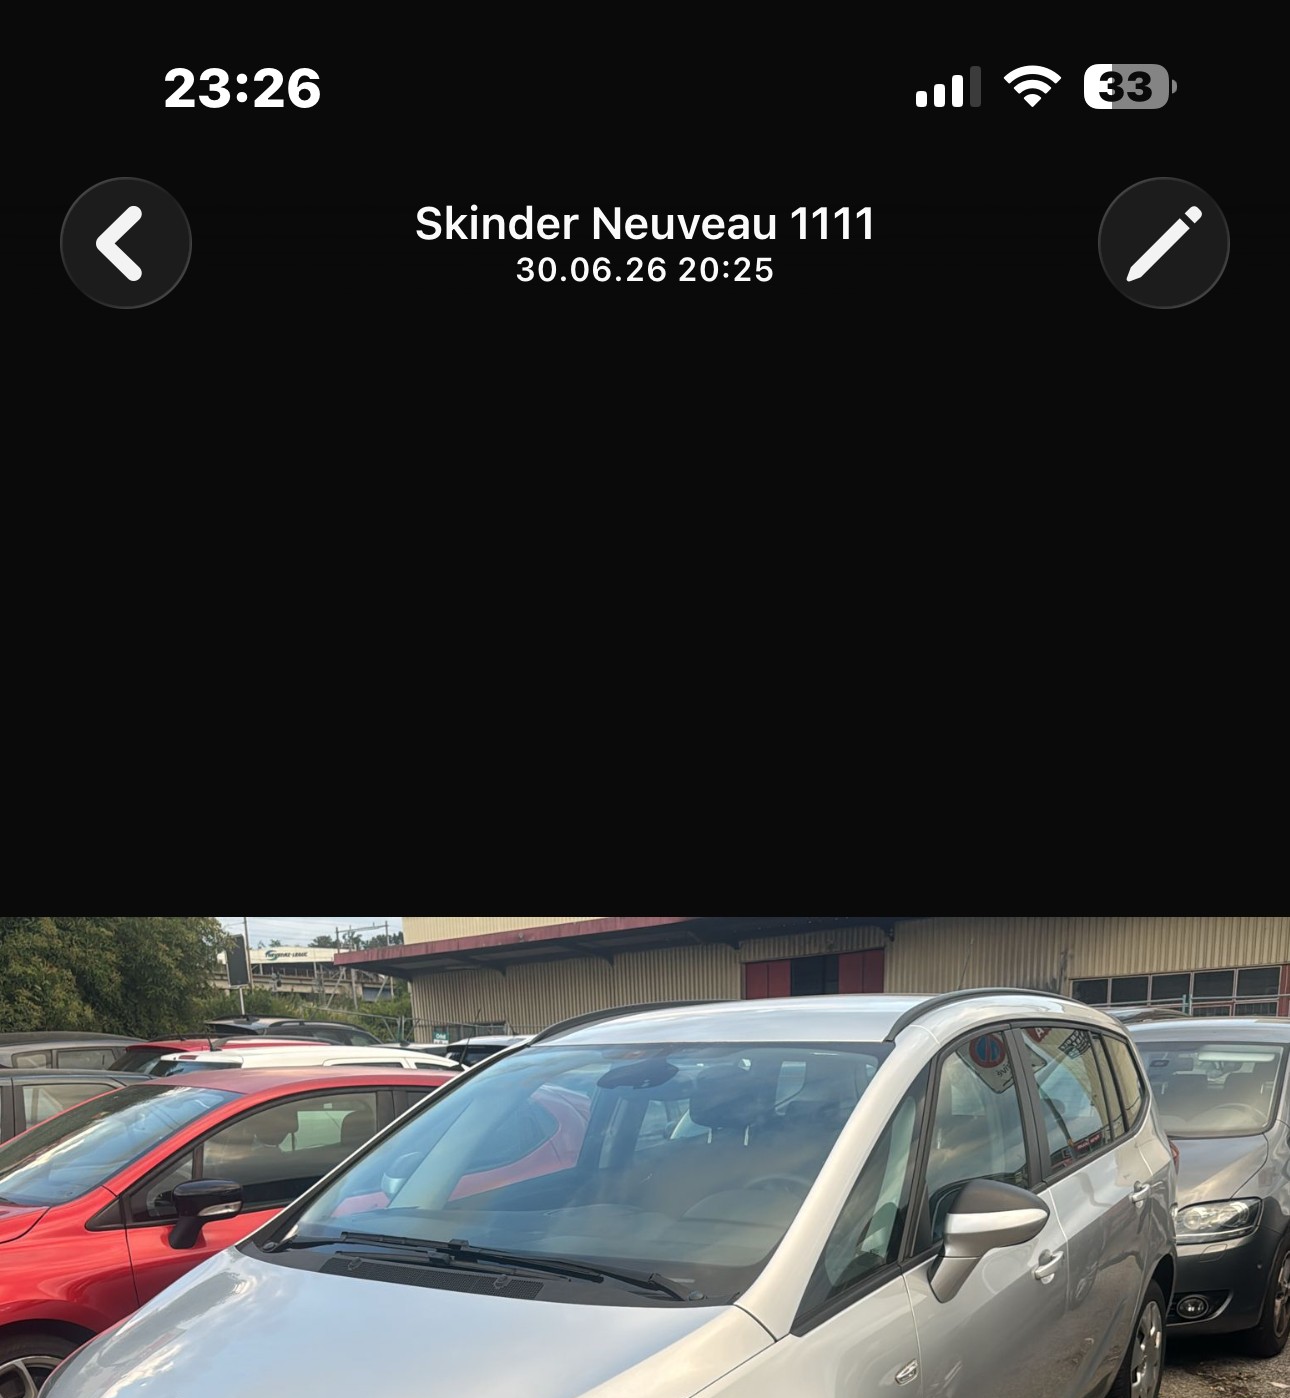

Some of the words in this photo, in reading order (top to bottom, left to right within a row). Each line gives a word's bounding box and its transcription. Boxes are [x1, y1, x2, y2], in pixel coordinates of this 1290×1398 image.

[164, 67, 321, 109] 23:26
[1098, 70, 1153, 103] 33
[415, 203, 580, 241] Skinder
[593, 206, 776, 241] Neuveau
[791, 206, 872, 240] 1111
[516, 256, 667, 283] 30.06.26
[678, 256, 774, 283] 20:25
